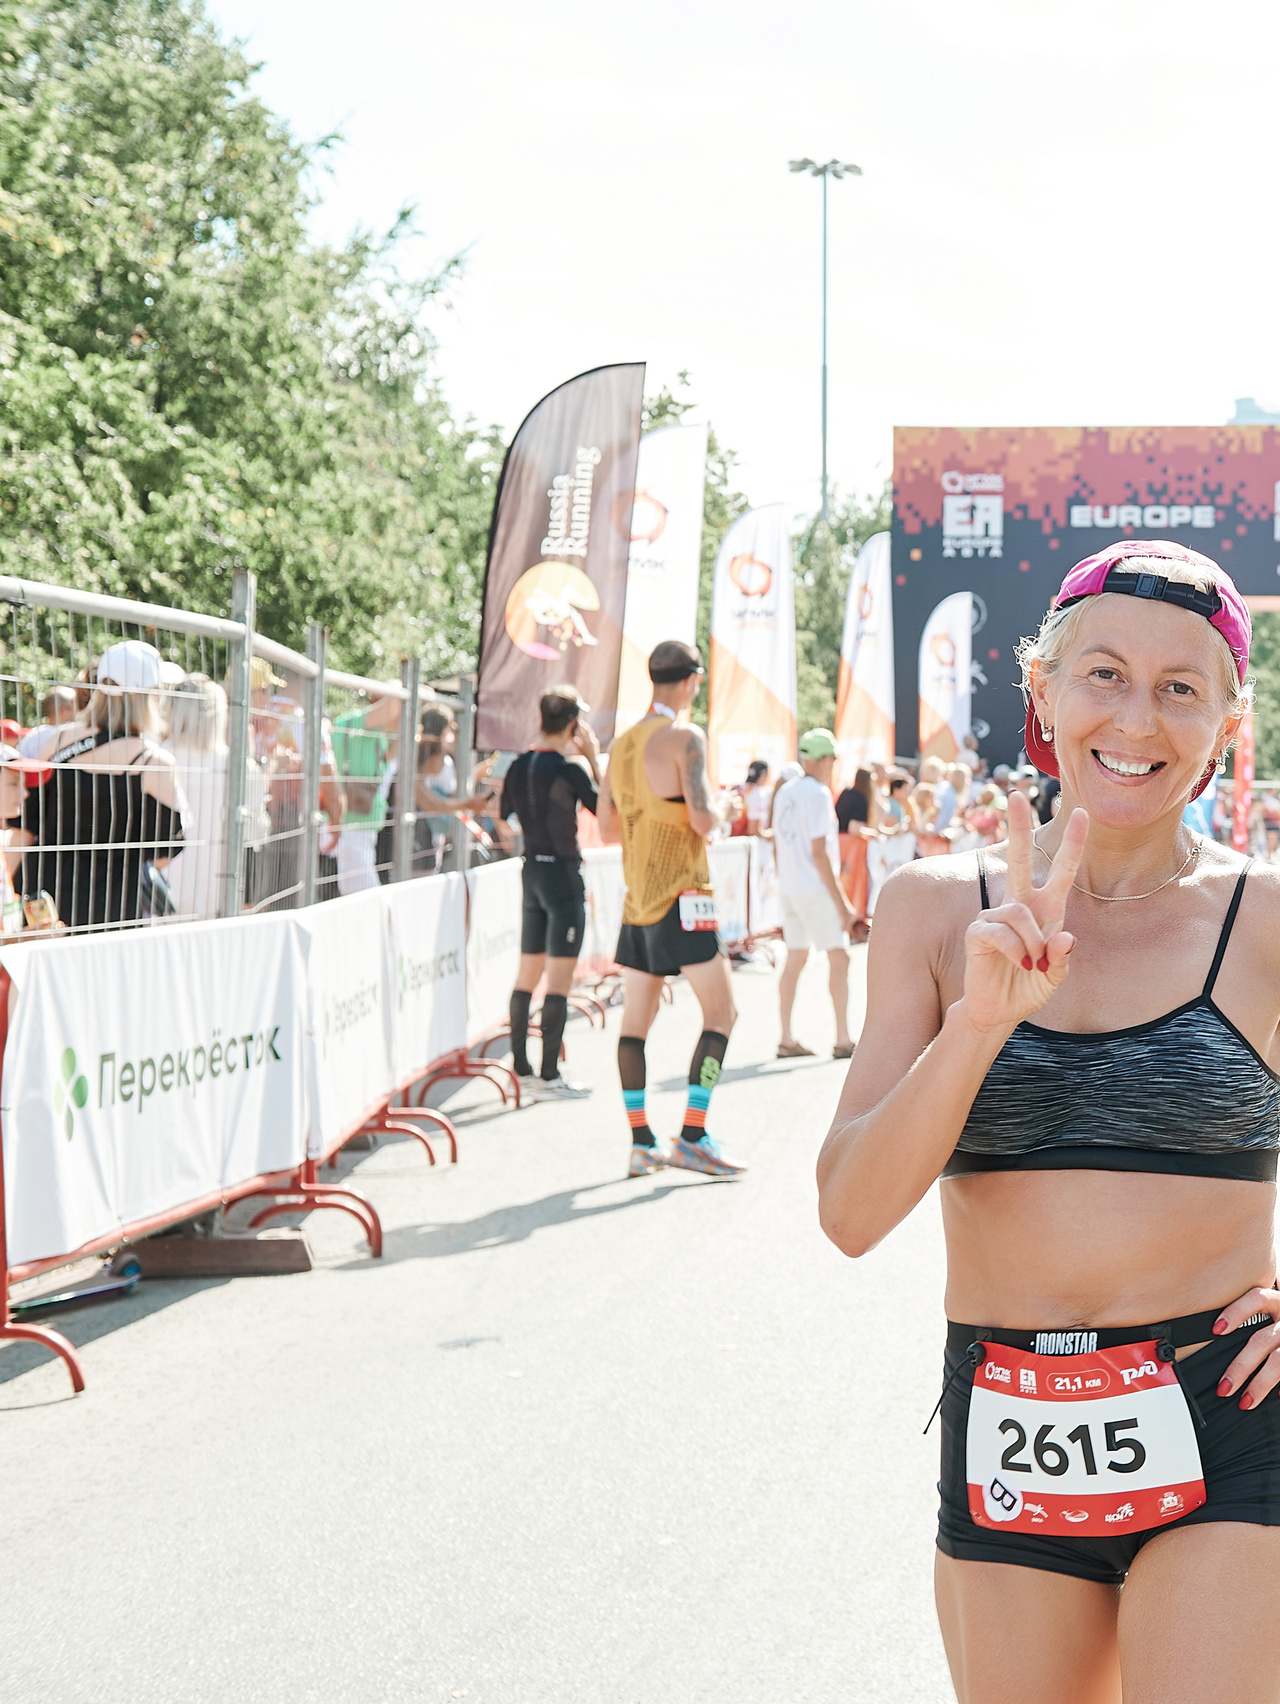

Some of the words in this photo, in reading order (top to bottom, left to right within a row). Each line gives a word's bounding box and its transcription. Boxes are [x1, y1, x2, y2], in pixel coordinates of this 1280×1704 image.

[541, 474, 571, 556] Russia
[562, 446, 601, 557] Running
[1070, 505, 1215, 527] EUROPE
[98, 1025, 281, 1113] Перекрёсток
[1035, 1332, 1098, 1355] IRONSTAR
[1054, 1376, 1082, 1392] 21,1
[997, 1417, 1146, 1476] 2615
